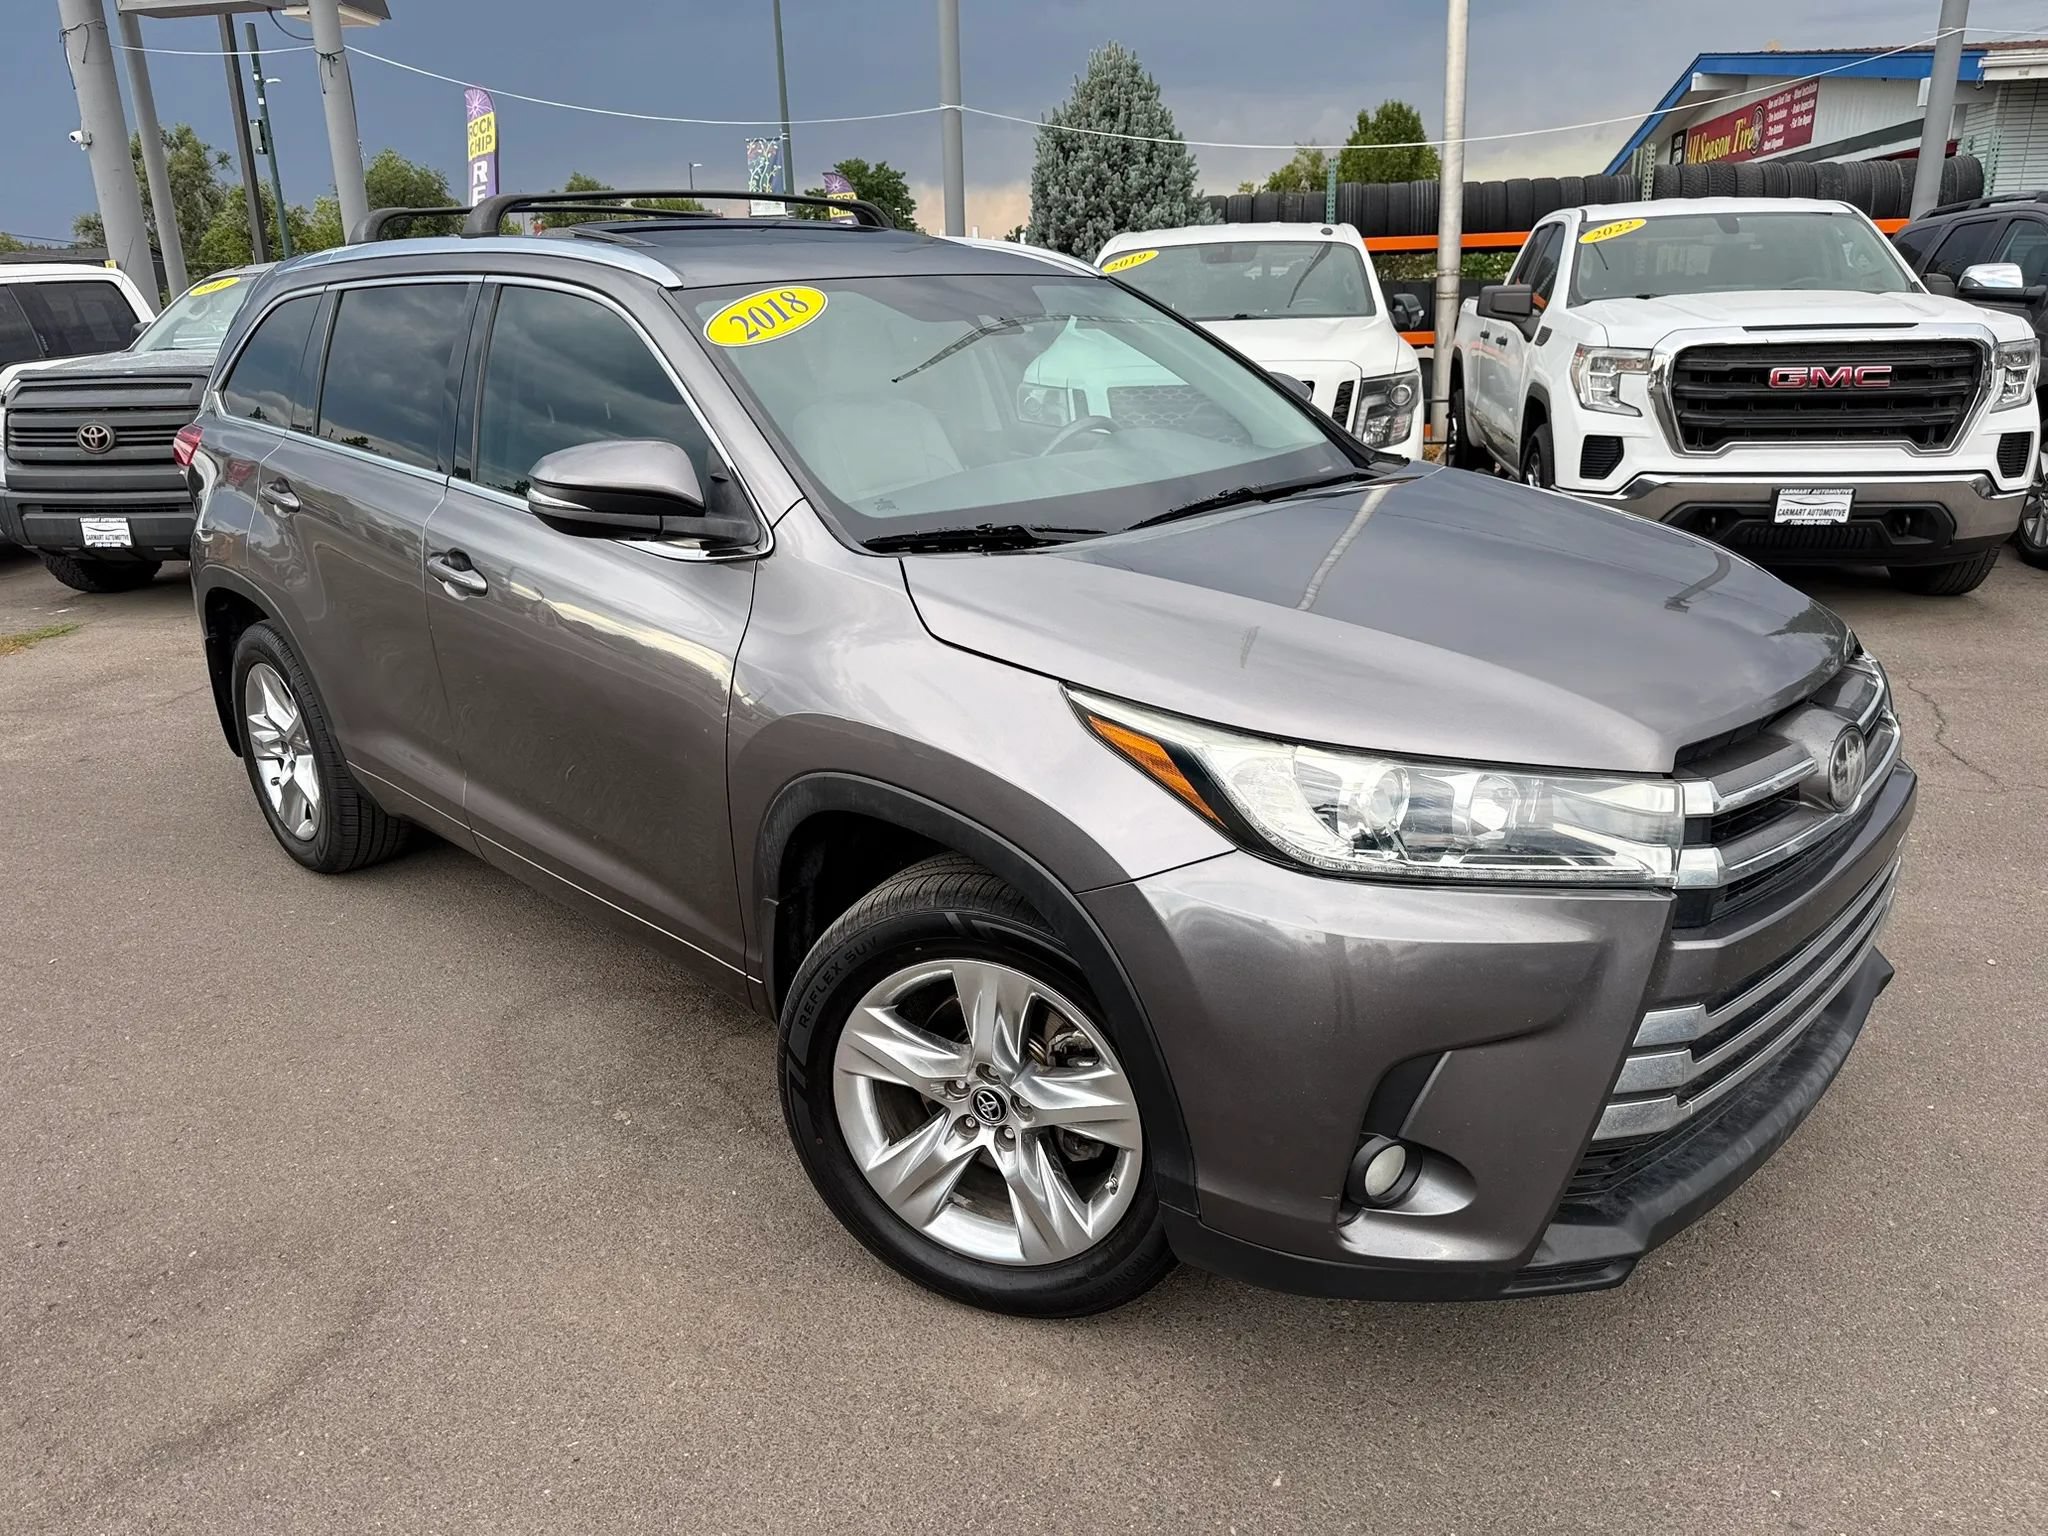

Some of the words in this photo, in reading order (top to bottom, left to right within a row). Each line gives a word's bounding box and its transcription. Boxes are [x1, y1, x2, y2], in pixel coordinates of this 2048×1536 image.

[469, 134, 493, 157] CHIP
[1698, 132, 1731, 163] Season
[1732, 117, 1755, 154] Tire
[1593, 221, 1633, 240] 2022
[1111, 253, 1147, 271] 2019
[729, 291, 809, 340] 2018
[1769, 366, 1892, 389] GMC
[1777, 508, 1807, 517] CARMART
[1807, 508, 1847, 517] AUTOMOTIVE
[799, 961, 843, 1029] REFLEX
[844, 936, 878, 964] SUV
